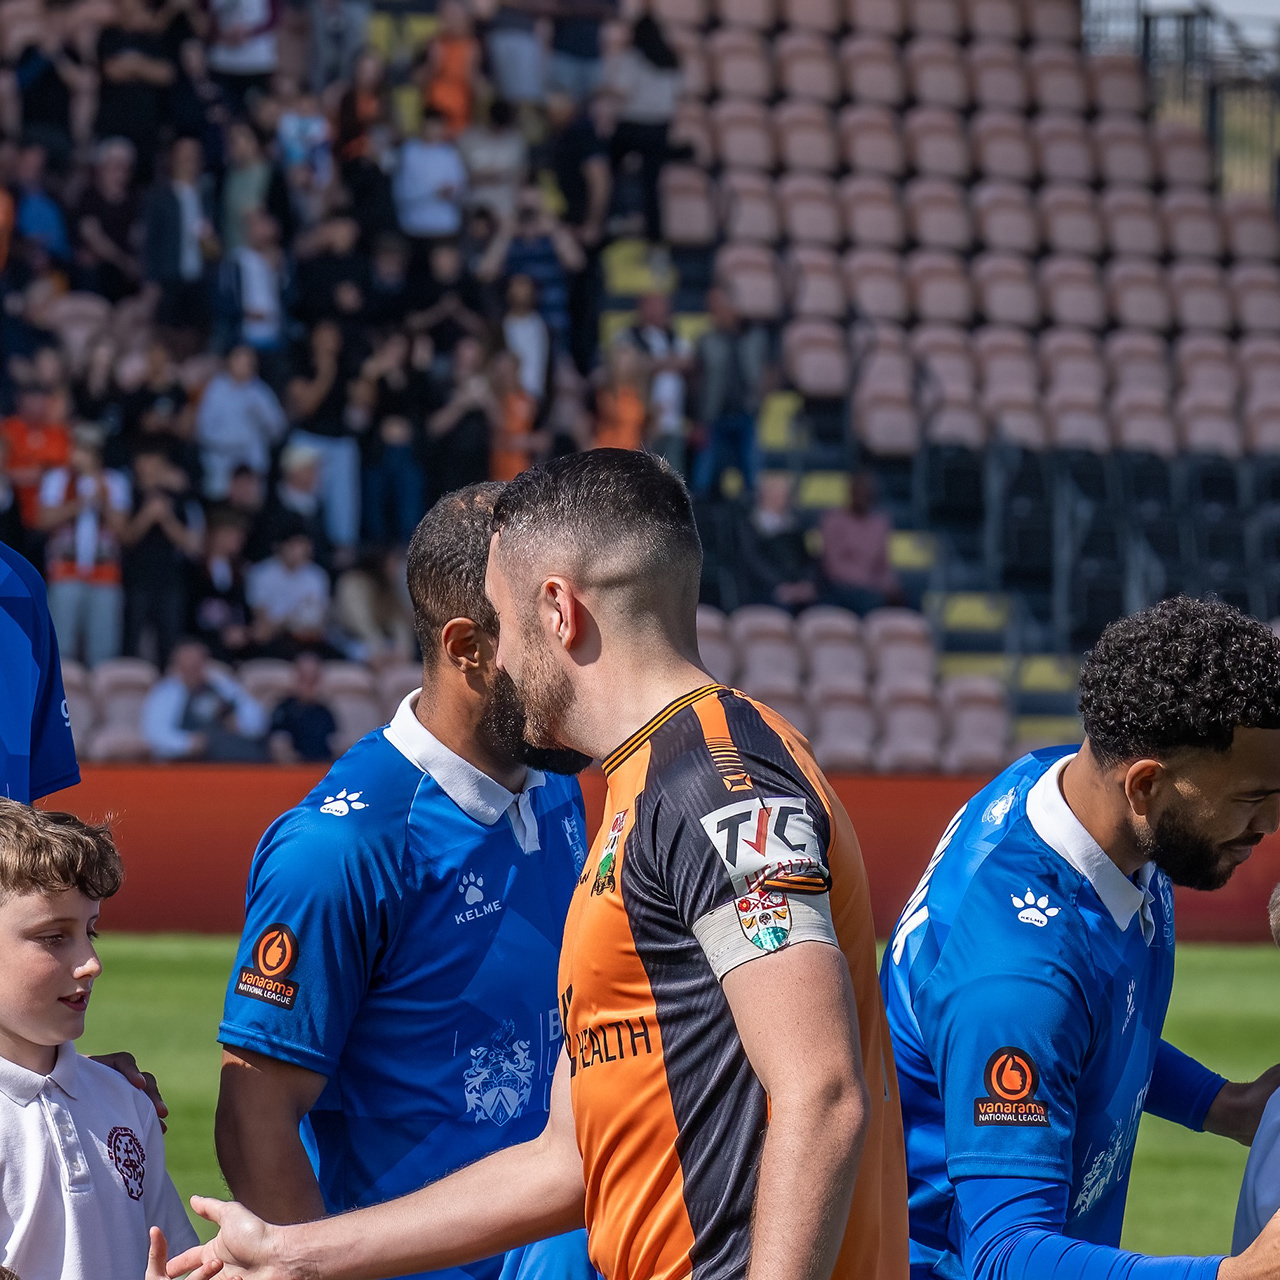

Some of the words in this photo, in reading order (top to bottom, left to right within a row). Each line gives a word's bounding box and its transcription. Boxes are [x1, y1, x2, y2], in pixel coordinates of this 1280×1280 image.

[454, 900, 503, 925] KELME
[238, 982, 264, 997] NATIONAL
[264, 990, 291, 1005] LEAGUE
[241, 972, 294, 997] vanarama
[575, 1015, 652, 1070] HEALTH
[978, 1102, 1045, 1115] vanarama
[978, 1113, 1017, 1122] NATIONAL
